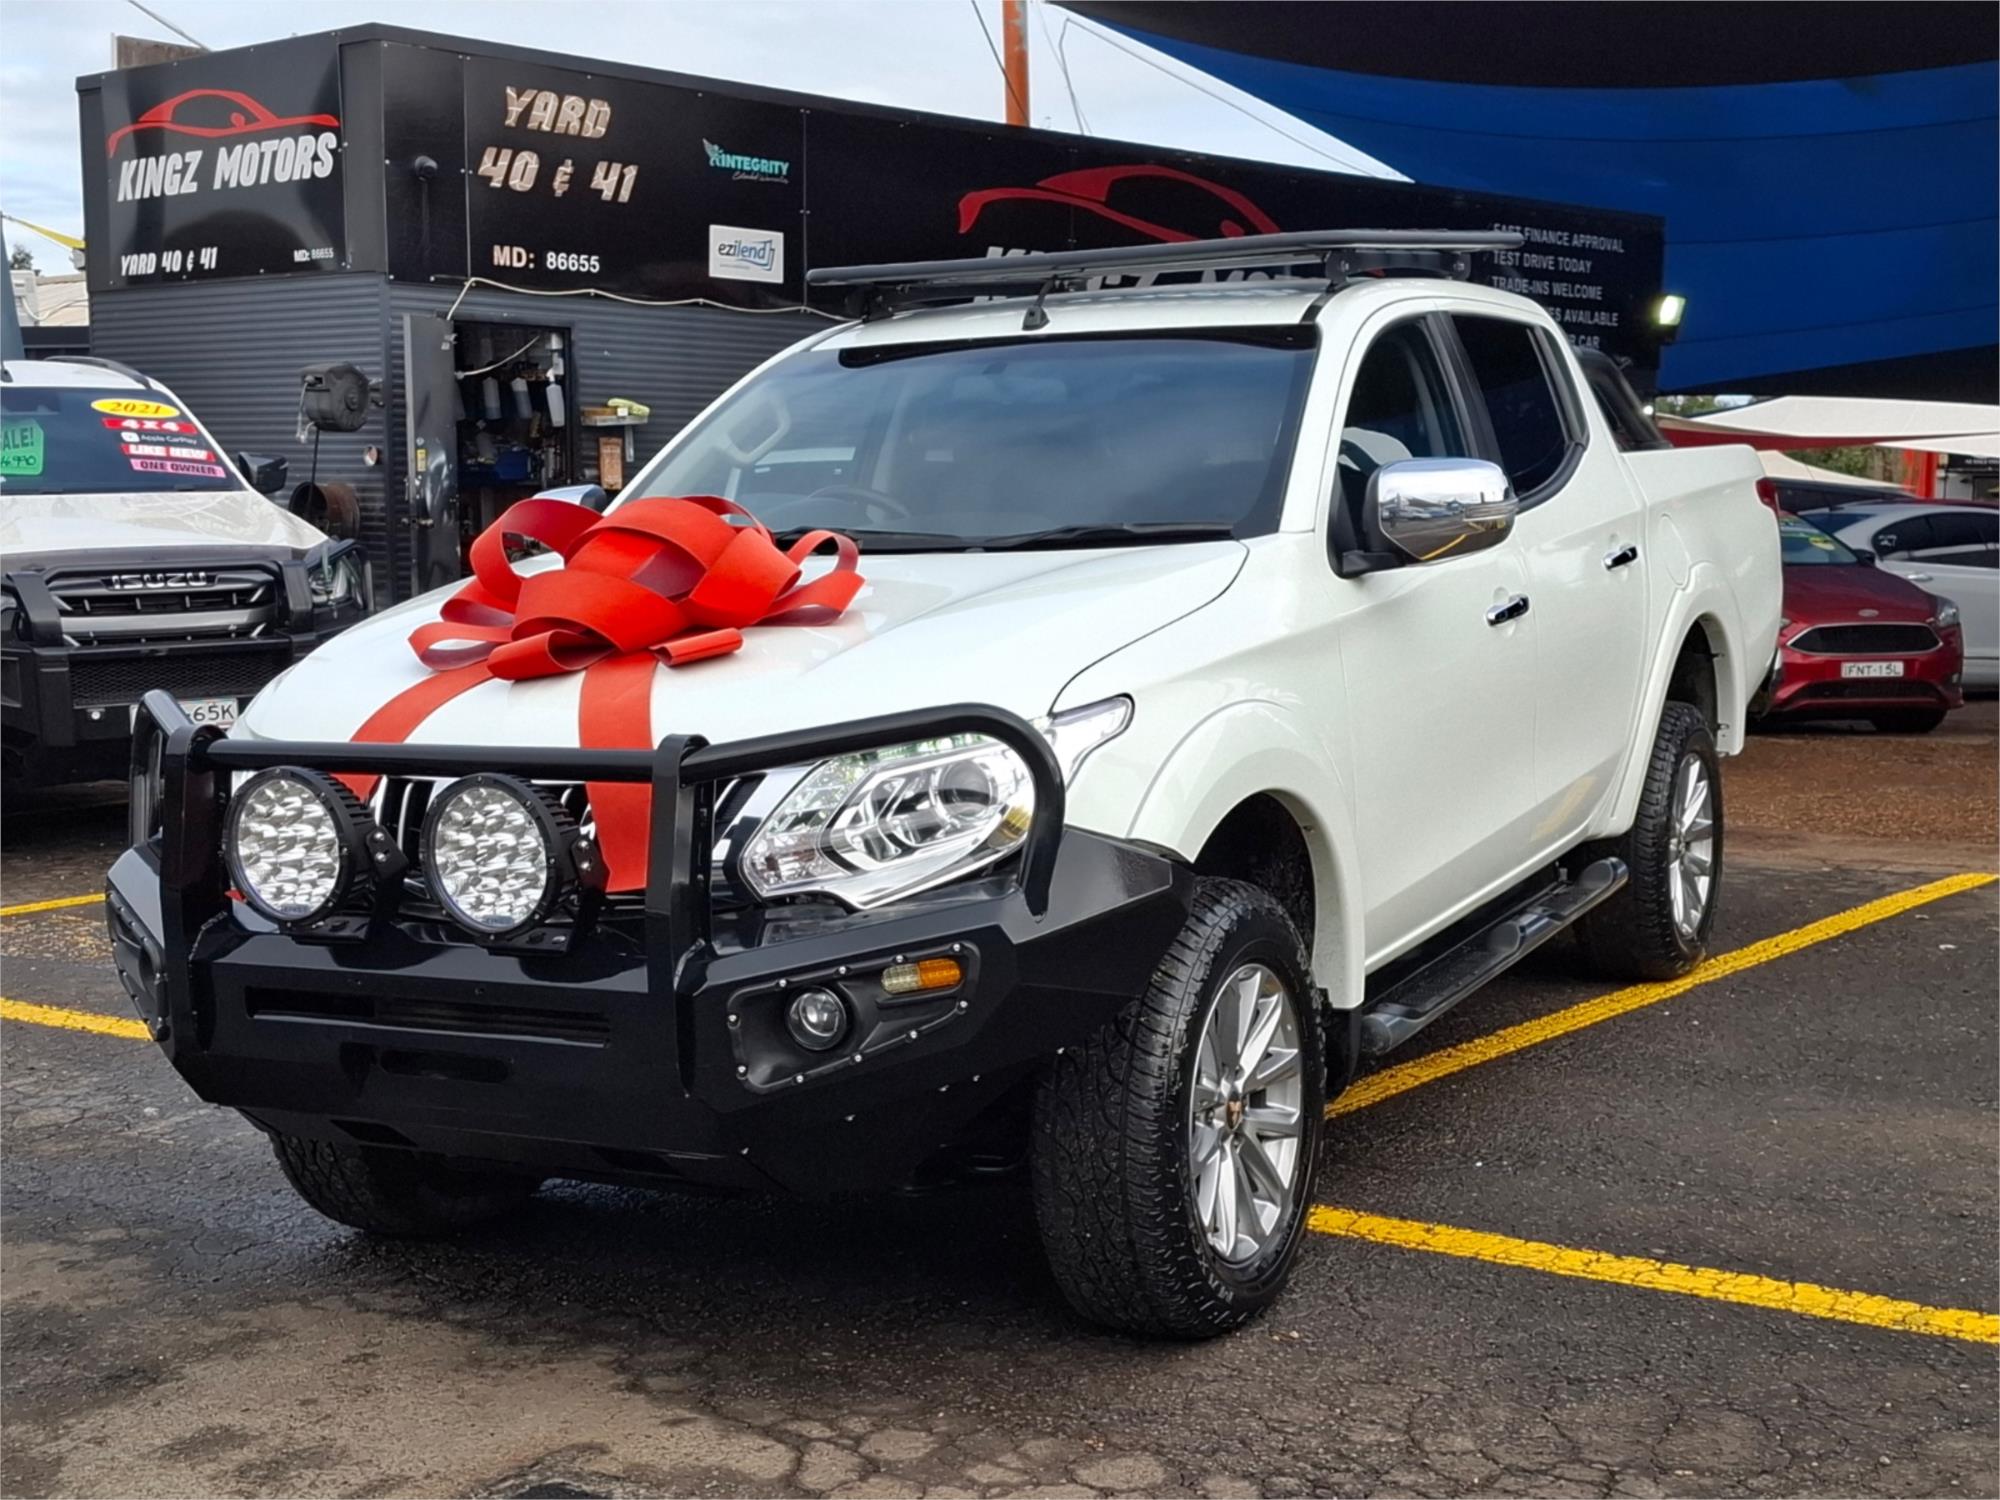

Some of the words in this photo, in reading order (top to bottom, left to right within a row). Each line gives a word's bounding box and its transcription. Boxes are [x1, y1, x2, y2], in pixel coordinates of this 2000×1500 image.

[505, 86, 611, 139] YARD
[117, 150, 203, 202] KINGZ
[213, 132, 338, 190] MOTORS
[477, 146, 540, 192] 40
[590, 160, 639, 204] 41
[721, 154, 790, 176] INTEGRITY
[718, 240, 766, 260] ezilend
[1524, 227, 1570, 246] FINANCE
[1572, 233, 1624, 253] APPROVAL
[121, 252, 157, 276] YARD
[161, 250, 182, 272] 40
[200, 247, 218, 270] 41
[493, 244, 535, 269] MD:
[546, 252, 600, 273] 86655
[1493, 250, 1521, 266] TEST
[1523, 253, 1555, 270] DRIVE
[1557, 257, 1592, 274] TODAY
[1492, 276, 1550, 295] TRADE-INS
[1552, 282, 1602, 300] WELCOME
[1563, 309, 1618, 326] AVAILABLE
[1578, 335, 1599, 348] CAR
[110, 402, 161, 415] 2021
[2, 427, 34, 451] ALE!
[140, 460, 168, 471] ONE
[170, 463, 217, 475] OWNER
[112, 571, 207, 590] ISUZU
[193, 704, 234, 721] 65K
